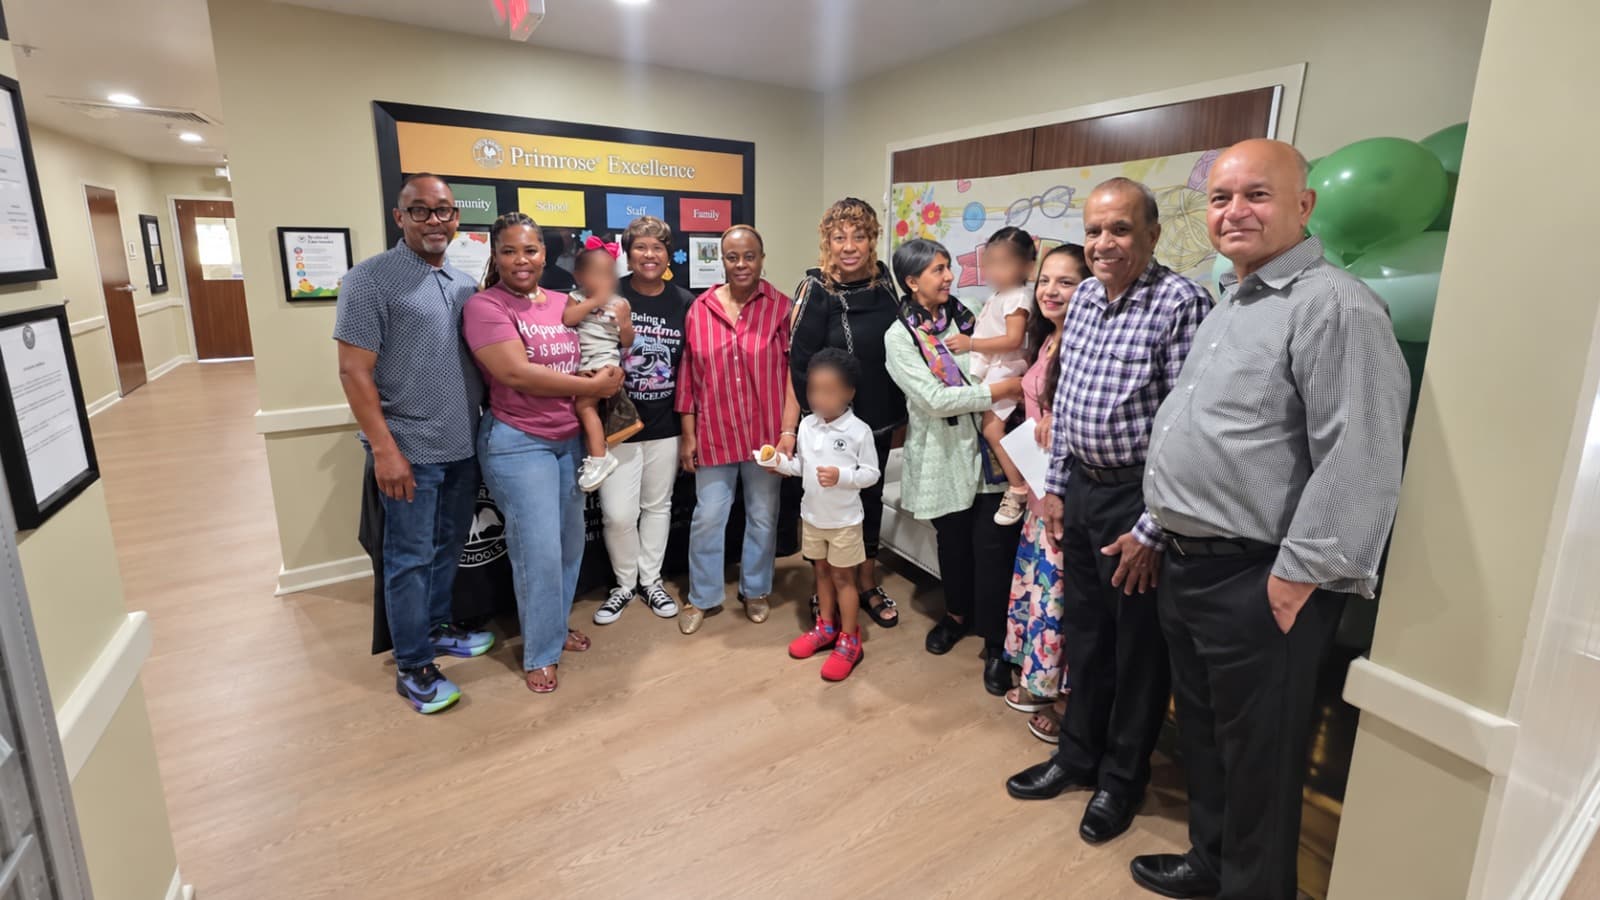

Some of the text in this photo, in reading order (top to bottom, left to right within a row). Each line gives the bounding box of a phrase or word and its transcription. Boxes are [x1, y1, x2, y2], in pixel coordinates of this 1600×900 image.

[510, 146, 597, 172] Primrose
[607, 154, 696, 179] Excellence
[453, 198, 492, 212] munity
[535, 200, 568, 213] School
[626, 205, 647, 216] Staff
[692, 208, 719, 221] Family
[631, 311, 666, 326] Being a
[539, 341, 575, 357] IS BEING
[459, 543, 504, 564] CHOOLS
